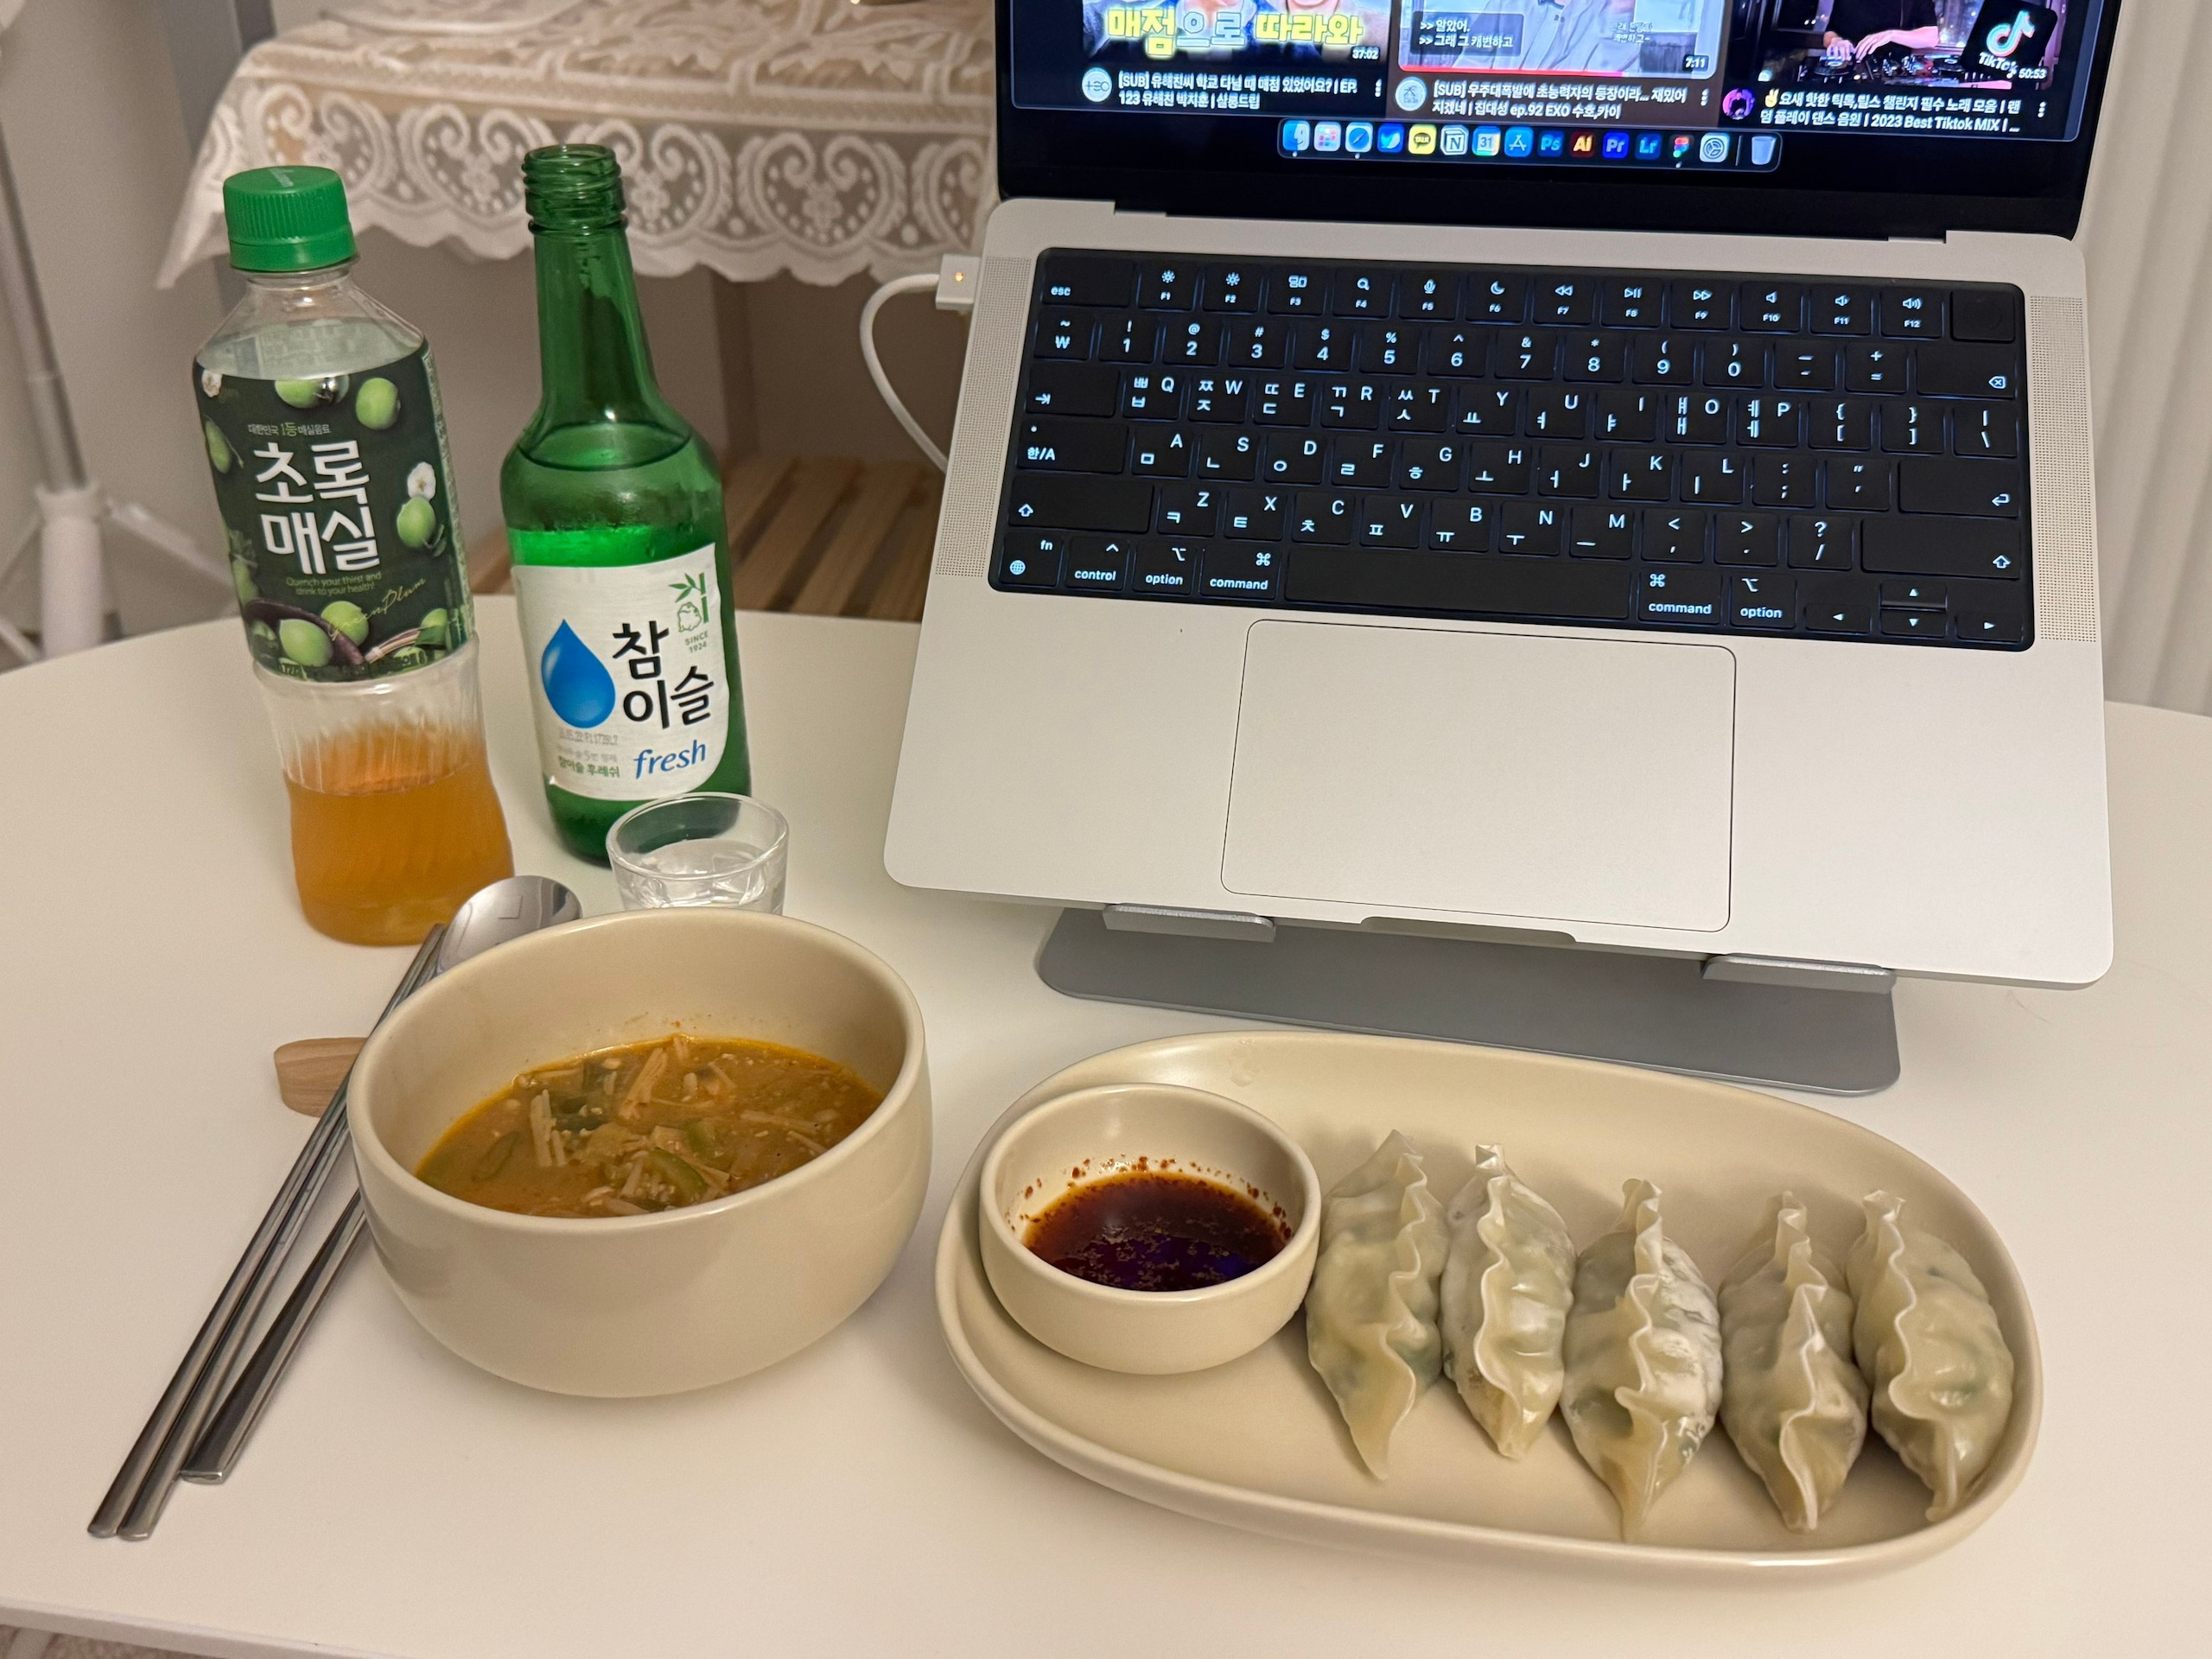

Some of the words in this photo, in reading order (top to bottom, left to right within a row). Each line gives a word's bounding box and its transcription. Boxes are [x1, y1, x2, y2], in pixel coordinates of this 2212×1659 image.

[1108, 8, 1246, 56] 매점으로
[1255, 13, 1364, 46] 따라와
[1435, 18, 1470, 32] 알았어.
[1434, 35, 1458, 47] 그래
[1459, 35, 1469, 47] 그
[1352, 48, 1380, 60] 37:02
[1684, 57, 1706, 68] 7:11
[1118, 71, 1150, 89] [SUB]
[1151, 73, 1194, 90] 유해진씨
[1196, 73, 1219, 90] 학교
[1220, 74, 1243, 92] 다닐
[1244, 74, 1257, 92] 때
[1258, 76, 1280, 92] 매점
[1282, 76, 1333, 93] 있었어요?
[1340, 79, 1357, 93] EP.
[2018, 67, 2048, 79] 50:53
[1118, 90, 1140, 105] 123
[1141, 90, 1175, 106] 유해진
[1176, 91, 1210, 108] 박지훈
[1217, 92, 1261, 109] 살롱드립
[1433, 79, 1467, 99] [SUB]
[1468, 80, 1535, 99] 우주대폭발에
[1536, 82, 1594, 101] 초능력자의
[1651, 86, 1688, 104] 재밌어
[1432, 99, 1467, 115] 지겠네
[1475, 99, 1510, 117] 집대성
[1510, 102, 1545, 118] ep.92
[1545, 103, 1572, 118] EXO
[1779, 91, 1804, 107] 요새
[1883, 94, 1919, 111] 챌린지
[1921, 95, 1946, 111] 필수
[1946, 97, 1972, 112] 노래
[1973, 98, 1998, 113] 모음
[1774, 109, 1811, 125] 플레이
[1837, 112, 1861, 127] 음원
[1870, 114, 1903, 128] 2023
[1904, 115, 1933, 129] Best
[1934, 117, 1974, 130] Tiktok
[1974, 118, 2001, 131] MIX
[1479, 137, 1494, 147] 31
[1541, 137, 1560, 151] Ps
[1573, 136, 1593, 152] Ai
[1605, 137, 1625, 152] Pr
[1638, 139, 1658, 154] Lr
[1051, 286, 1071, 296] esc
[1160, 292, 1171, 301] F1
[1225, 294, 1236, 303] F2
[1289, 296, 1301, 306] F3
[1356, 299, 1367, 308] F4
[1422, 302, 1433, 311] F5
[1489, 304, 1501, 313] F6
[1557, 306, 1569, 315] F7
[1626, 308, 1638, 317] F8
[1695, 310, 1708, 320] F9
[1763, 313, 1781, 322] F10
[1834, 315, 1849, 325] F11
[1904, 319, 1921, 328] F12
[1122, 338, 1131, 353] 1
[1186, 341, 1198, 356] 2
[1250, 344, 1262, 359] 3
[1317, 346, 1329, 361] 4
[1384, 349, 1395, 365] 5
[1452, 352, 1464, 367] 6
[1519, 354, 1531, 369] 7
[1587, 357, 1600, 372] 8
[1657, 359, 1670, 375] 9
[1727, 361, 1741, 378] 0
[1160, 377, 1175, 393] Q
[1224, 380, 1243, 395] W
[1294, 383, 1306, 398] E
[1360, 385, 1373, 401] R
[1428, 388, 1440, 404] T
[1497, 391, 1510, 407] Y
[1564, 394, 1579, 410] U
[1705, 398, 1720, 415] O
[1777, 402, 1791, 417] P
[1027, 446, 1056, 461] 한/A
[1170, 433, 1183, 448] A
[1236, 436, 1249, 452] S
[1304, 441, 1318, 455] D
[1372, 444, 1384, 459] F
[1439, 447, 1452, 462] G
[1508, 449, 1522, 465] H
[1579, 453, 1590, 468] J
[1649, 455, 1663, 471] K
[1722, 458, 1734, 474] L
[253, 440, 371, 505] 초록
[1196, 492, 1210, 507] Z
[1263, 496, 1278, 512] X
[1332, 500, 1344, 516] C
[1400, 503, 1414, 518] V
[1469, 506, 1483, 523] B
[1539, 510, 1554, 525] N
[1608, 513, 1625, 529] M
[260, 506, 381, 575] 매실
[1040, 540, 1053, 550] fn
[286, 576, 320, 586] Quench
[321, 578, 341, 588] your
[342, 575, 364, 584] thirst
[365, 571, 382, 581] and
[1074, 569, 1117, 582] control
[1145, 573, 1184, 587] option
[1209, 578, 1268, 590] command
[328, 588, 347, 596] your
[1648, 602, 1713, 615] command
[1739, 606, 1783, 620] option
[685, 631, 709, 646] SINCE
[689, 640, 709, 654] 1924
[613, 620, 670, 680] 참
[622, 665, 715, 730] 이슬
[633, 740, 707, 779] fresh
